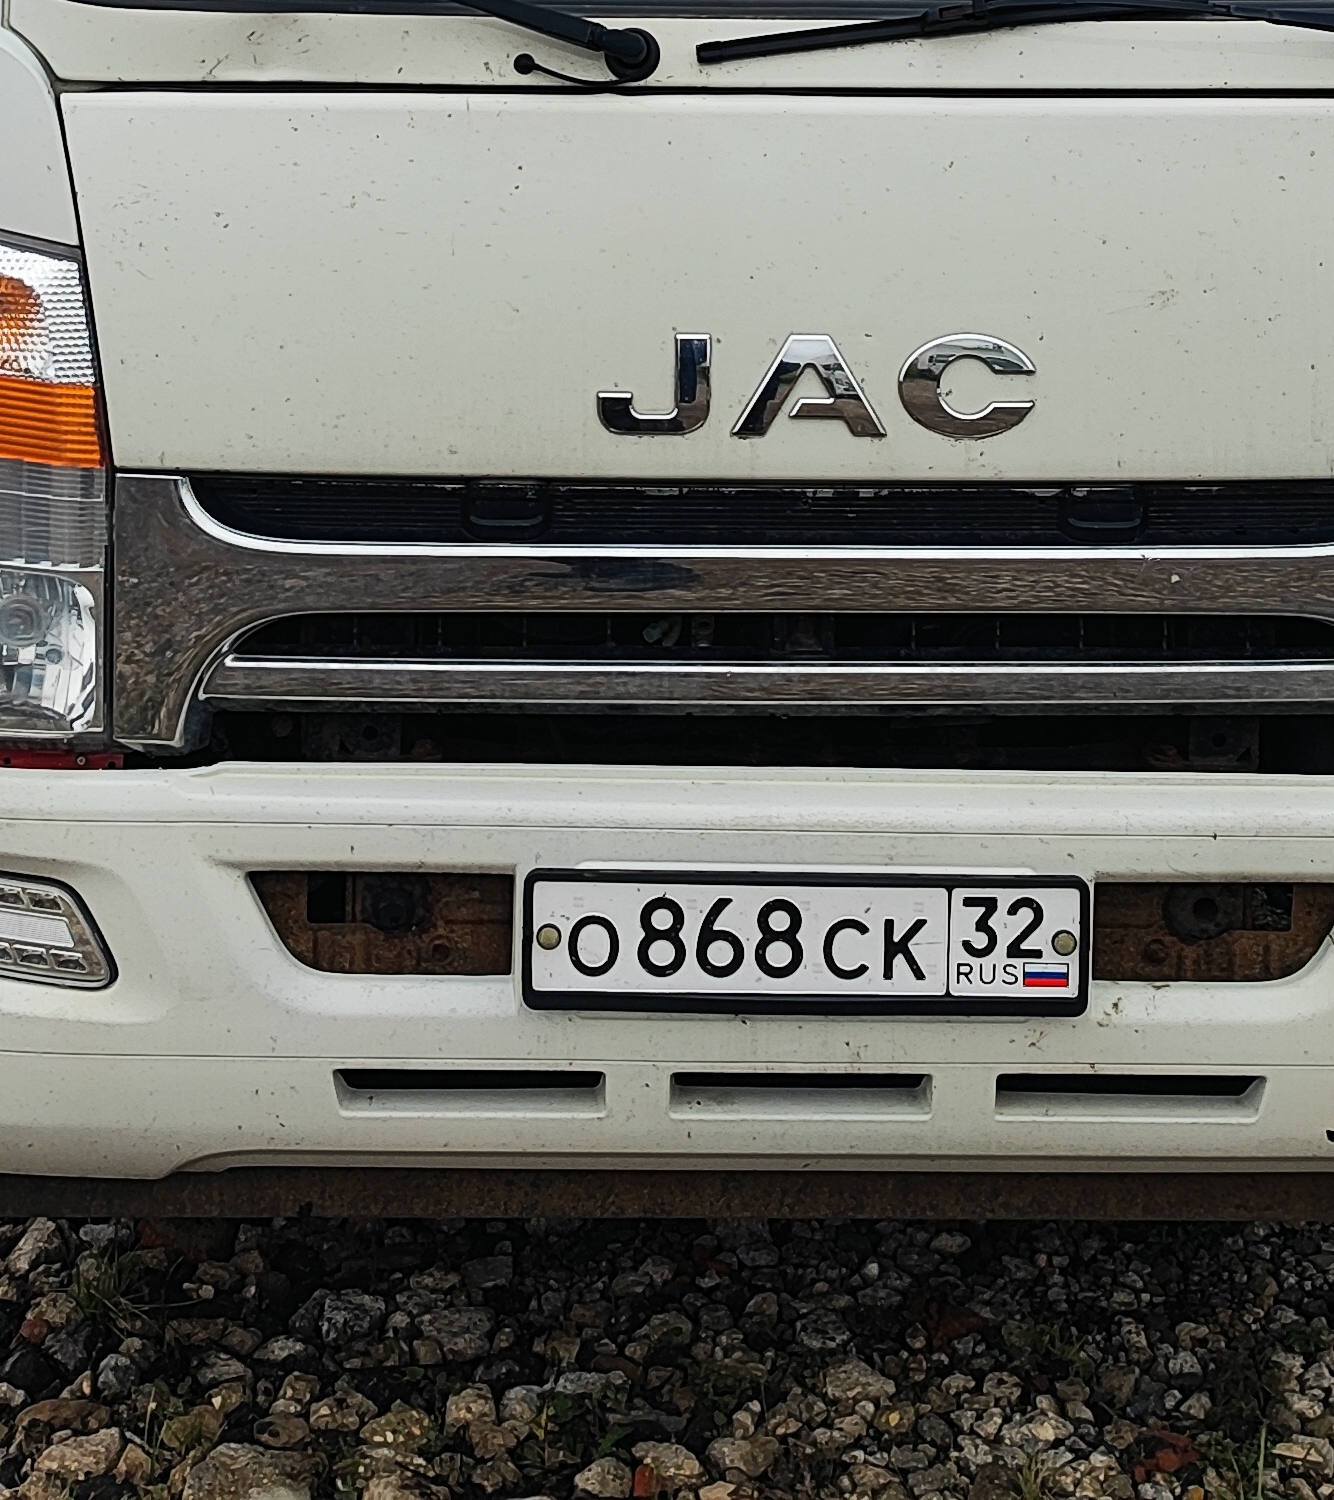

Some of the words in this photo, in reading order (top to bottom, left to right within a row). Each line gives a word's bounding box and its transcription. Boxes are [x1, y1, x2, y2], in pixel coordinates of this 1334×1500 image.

[596, 332, 1037, 439] JAC
[566, 895, 928, 981] О868СК
[962, 896, 1044, 960] 32
[956, 963, 1019, 986] RUS
